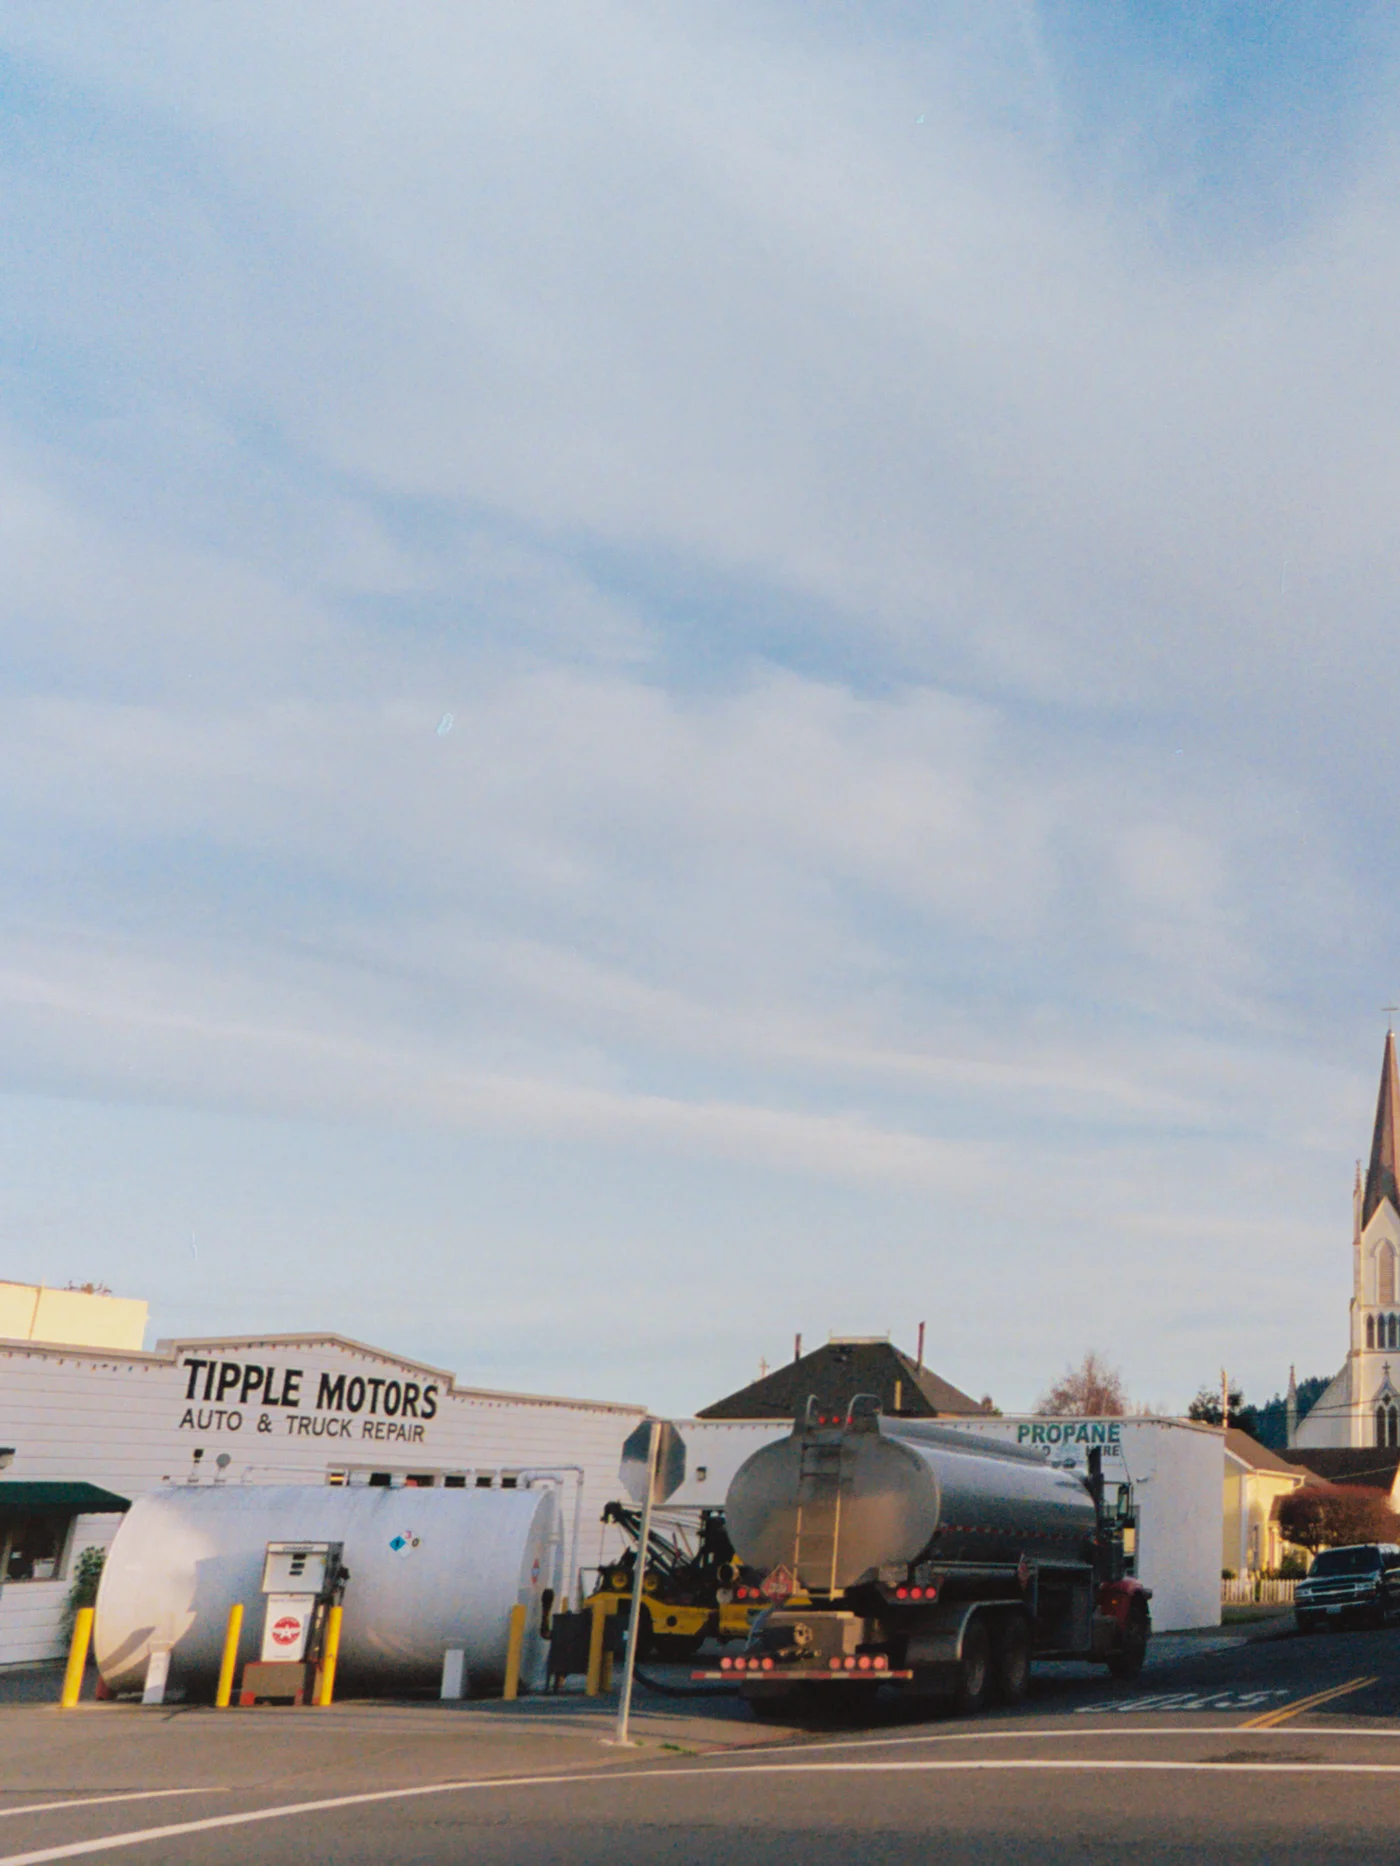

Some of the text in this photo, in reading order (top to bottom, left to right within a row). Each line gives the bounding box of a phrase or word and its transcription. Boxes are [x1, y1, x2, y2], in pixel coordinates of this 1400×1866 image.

[183, 1358, 438, 1419] TIPPLE MOTORS
[179, 1408, 425, 1442] AUTO & TRUCK REPAIR
[1017, 1423, 1120, 1443] PROPANE
[1085, 1445, 1120, 1456] HRE
